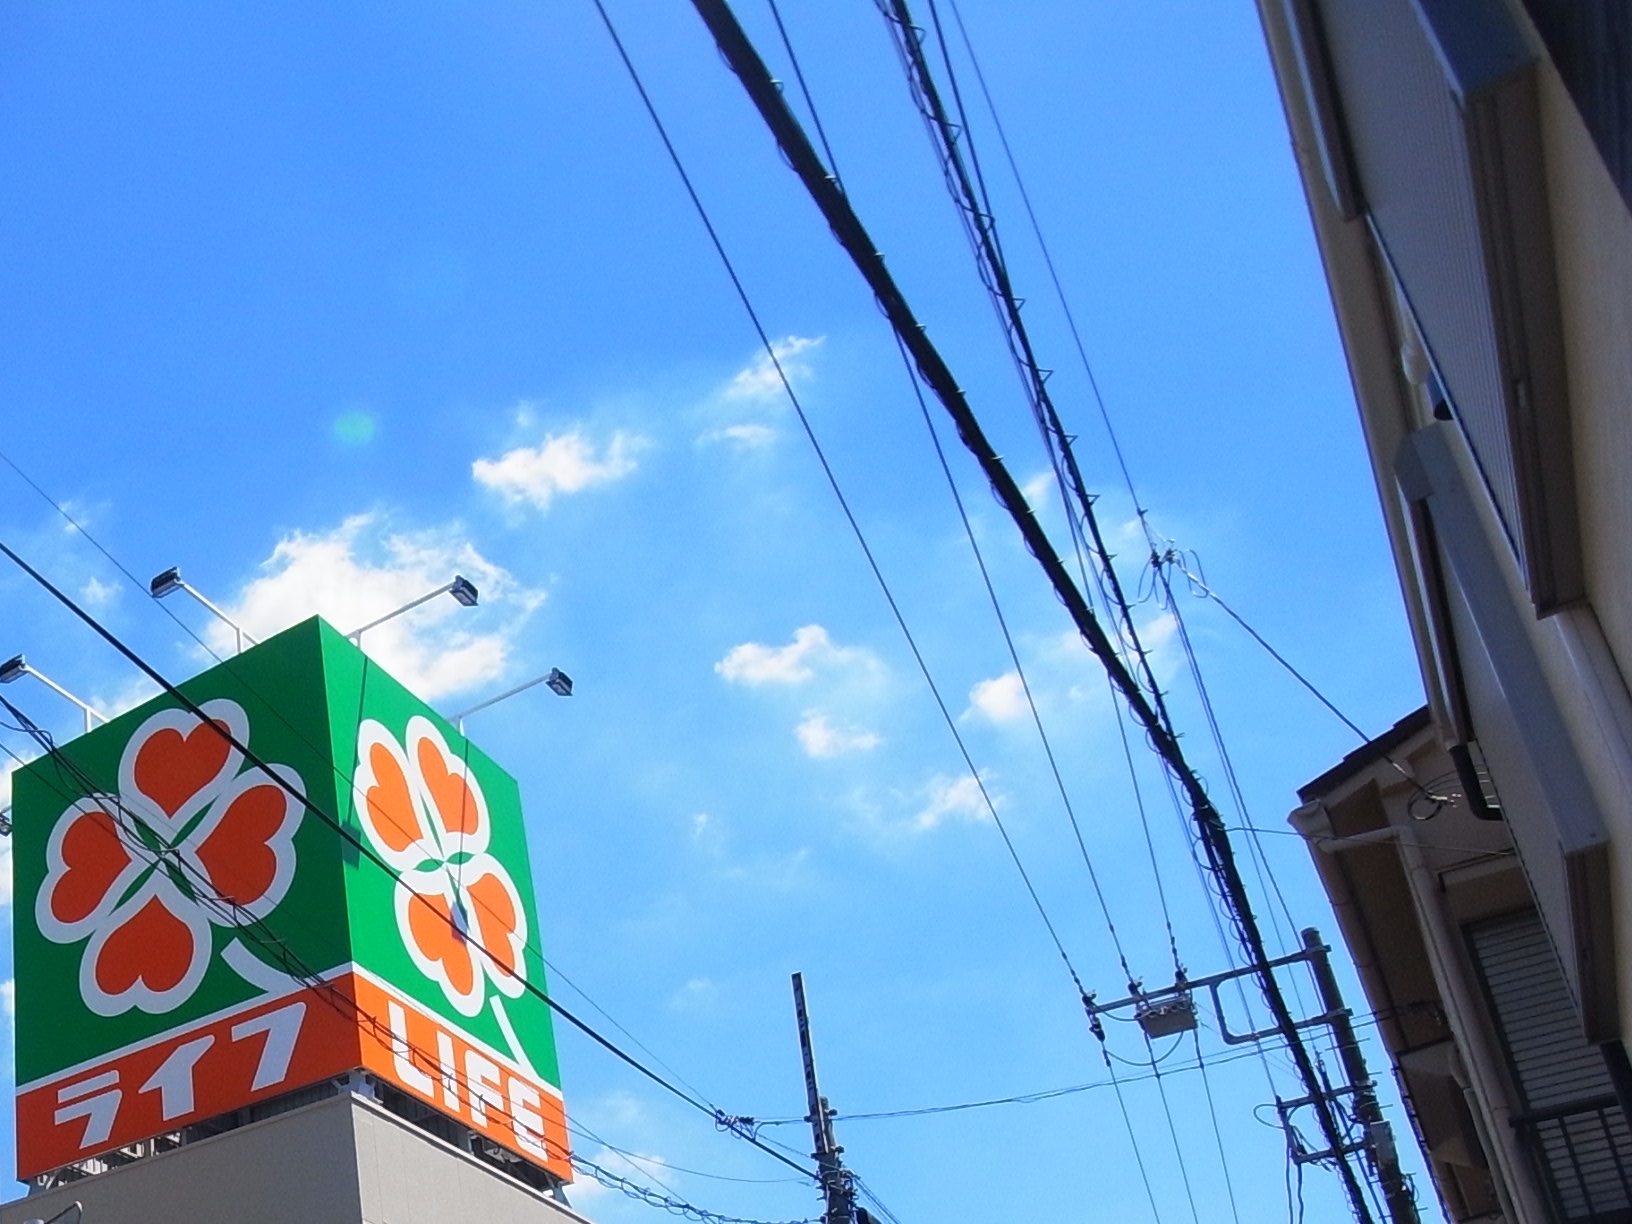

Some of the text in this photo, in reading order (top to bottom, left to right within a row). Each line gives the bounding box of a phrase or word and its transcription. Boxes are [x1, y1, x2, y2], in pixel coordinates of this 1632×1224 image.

[54, 1001, 308, 1149] ライフ
[387, 1000, 549, 1163] LIFE
